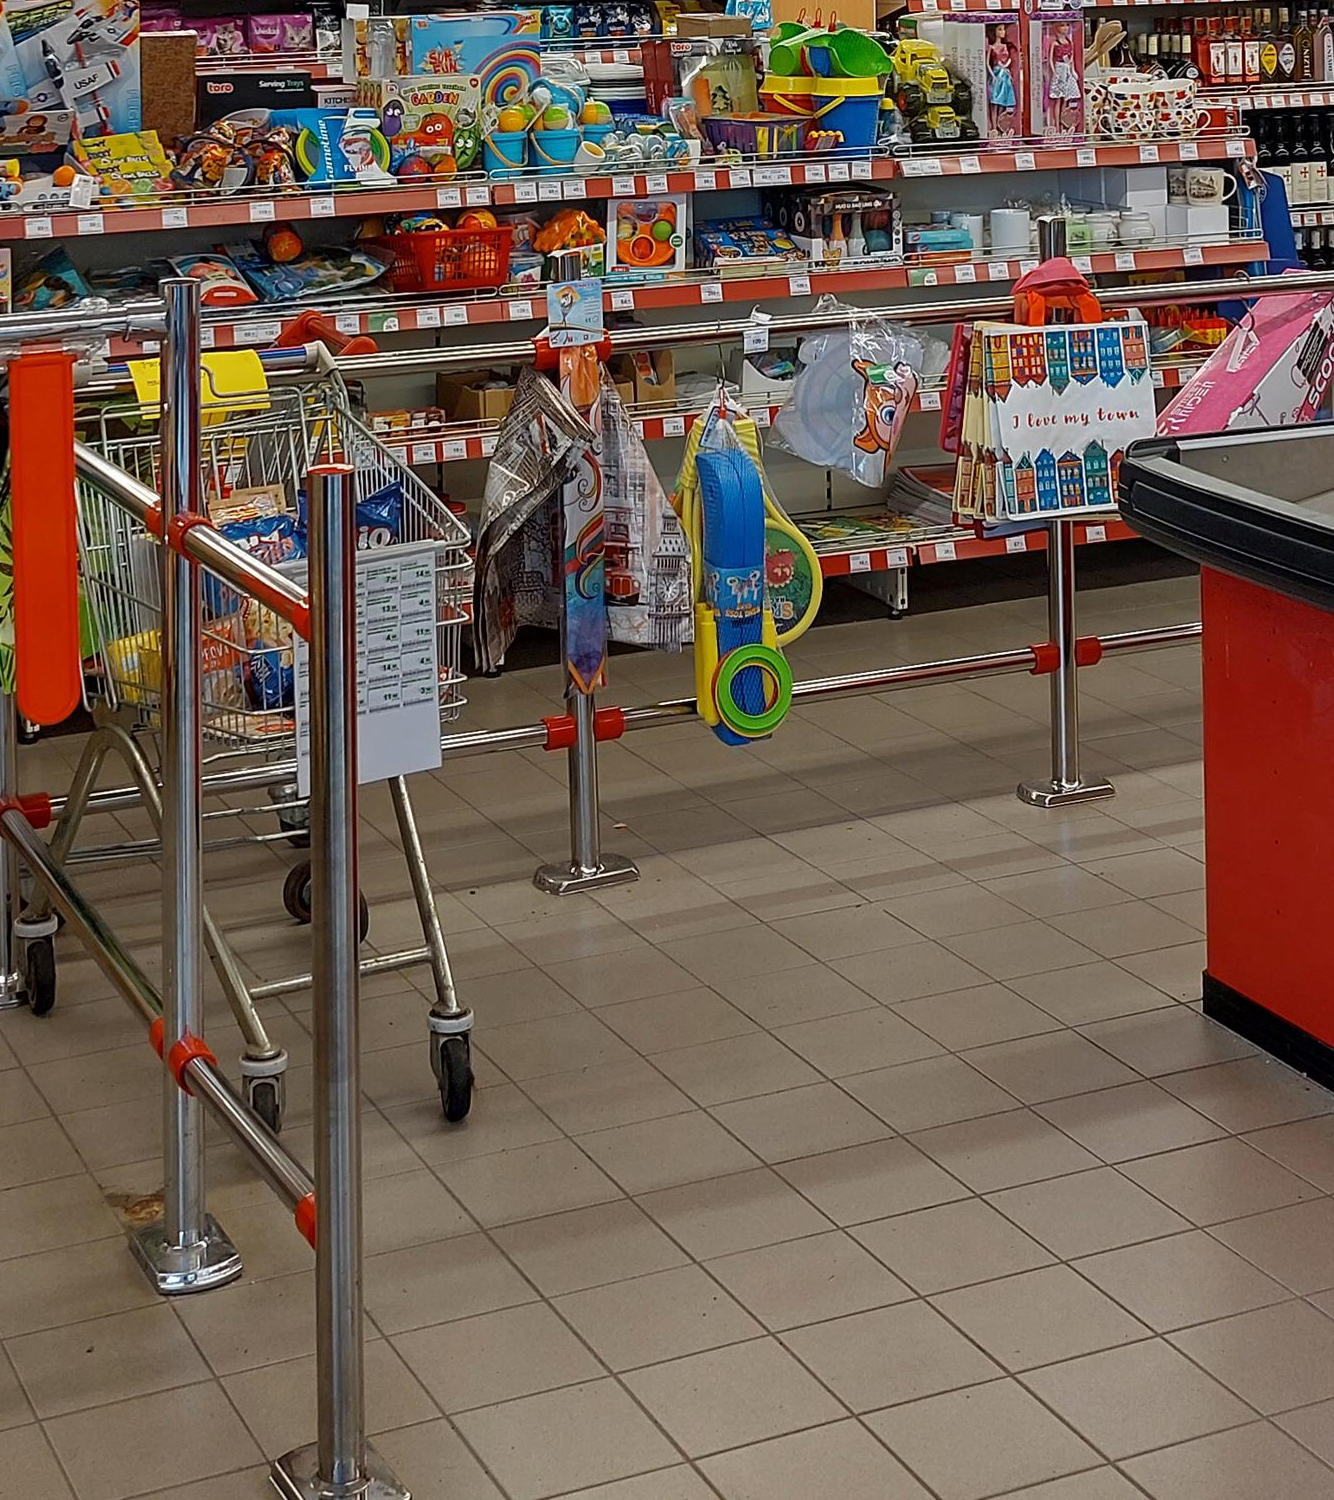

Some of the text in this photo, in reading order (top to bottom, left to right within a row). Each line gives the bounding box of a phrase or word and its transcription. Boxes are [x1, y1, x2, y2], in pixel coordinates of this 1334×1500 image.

[670, 42, 691, 52] toro
[74, 73, 99, 91] USAF
[207, 83, 233, 93] toro
[258, 80, 285, 89] Serving
[410, 91, 460, 106] GARDEN
[1012, 407, 1139, 430] I love my town
